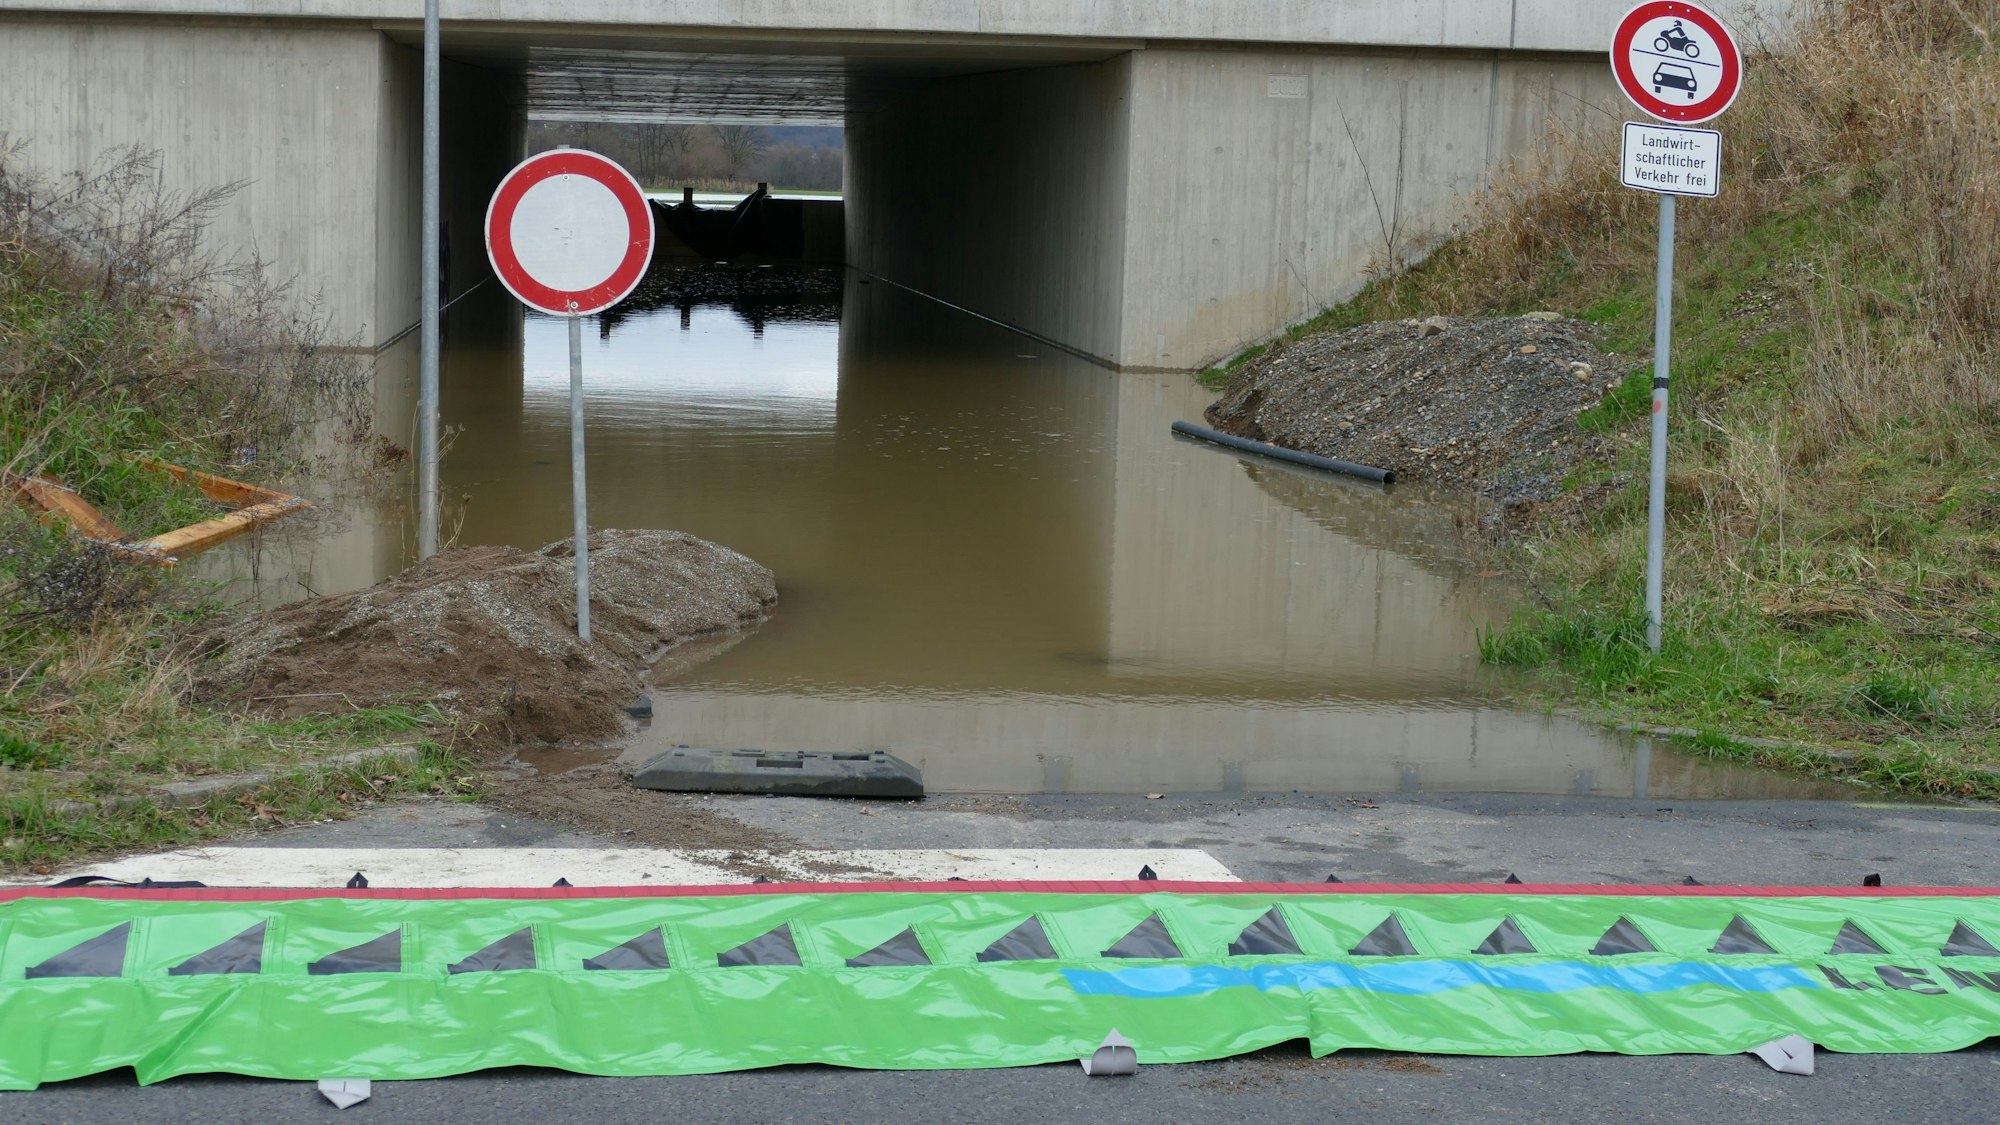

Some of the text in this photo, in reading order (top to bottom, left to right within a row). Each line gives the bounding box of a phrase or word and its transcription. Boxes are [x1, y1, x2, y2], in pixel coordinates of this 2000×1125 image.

[1642, 133, 1701, 151] Landwirt-
[1635, 152, 1706, 169] schaftlicher
[1634, 166, 1707, 187] Verkehr frei
